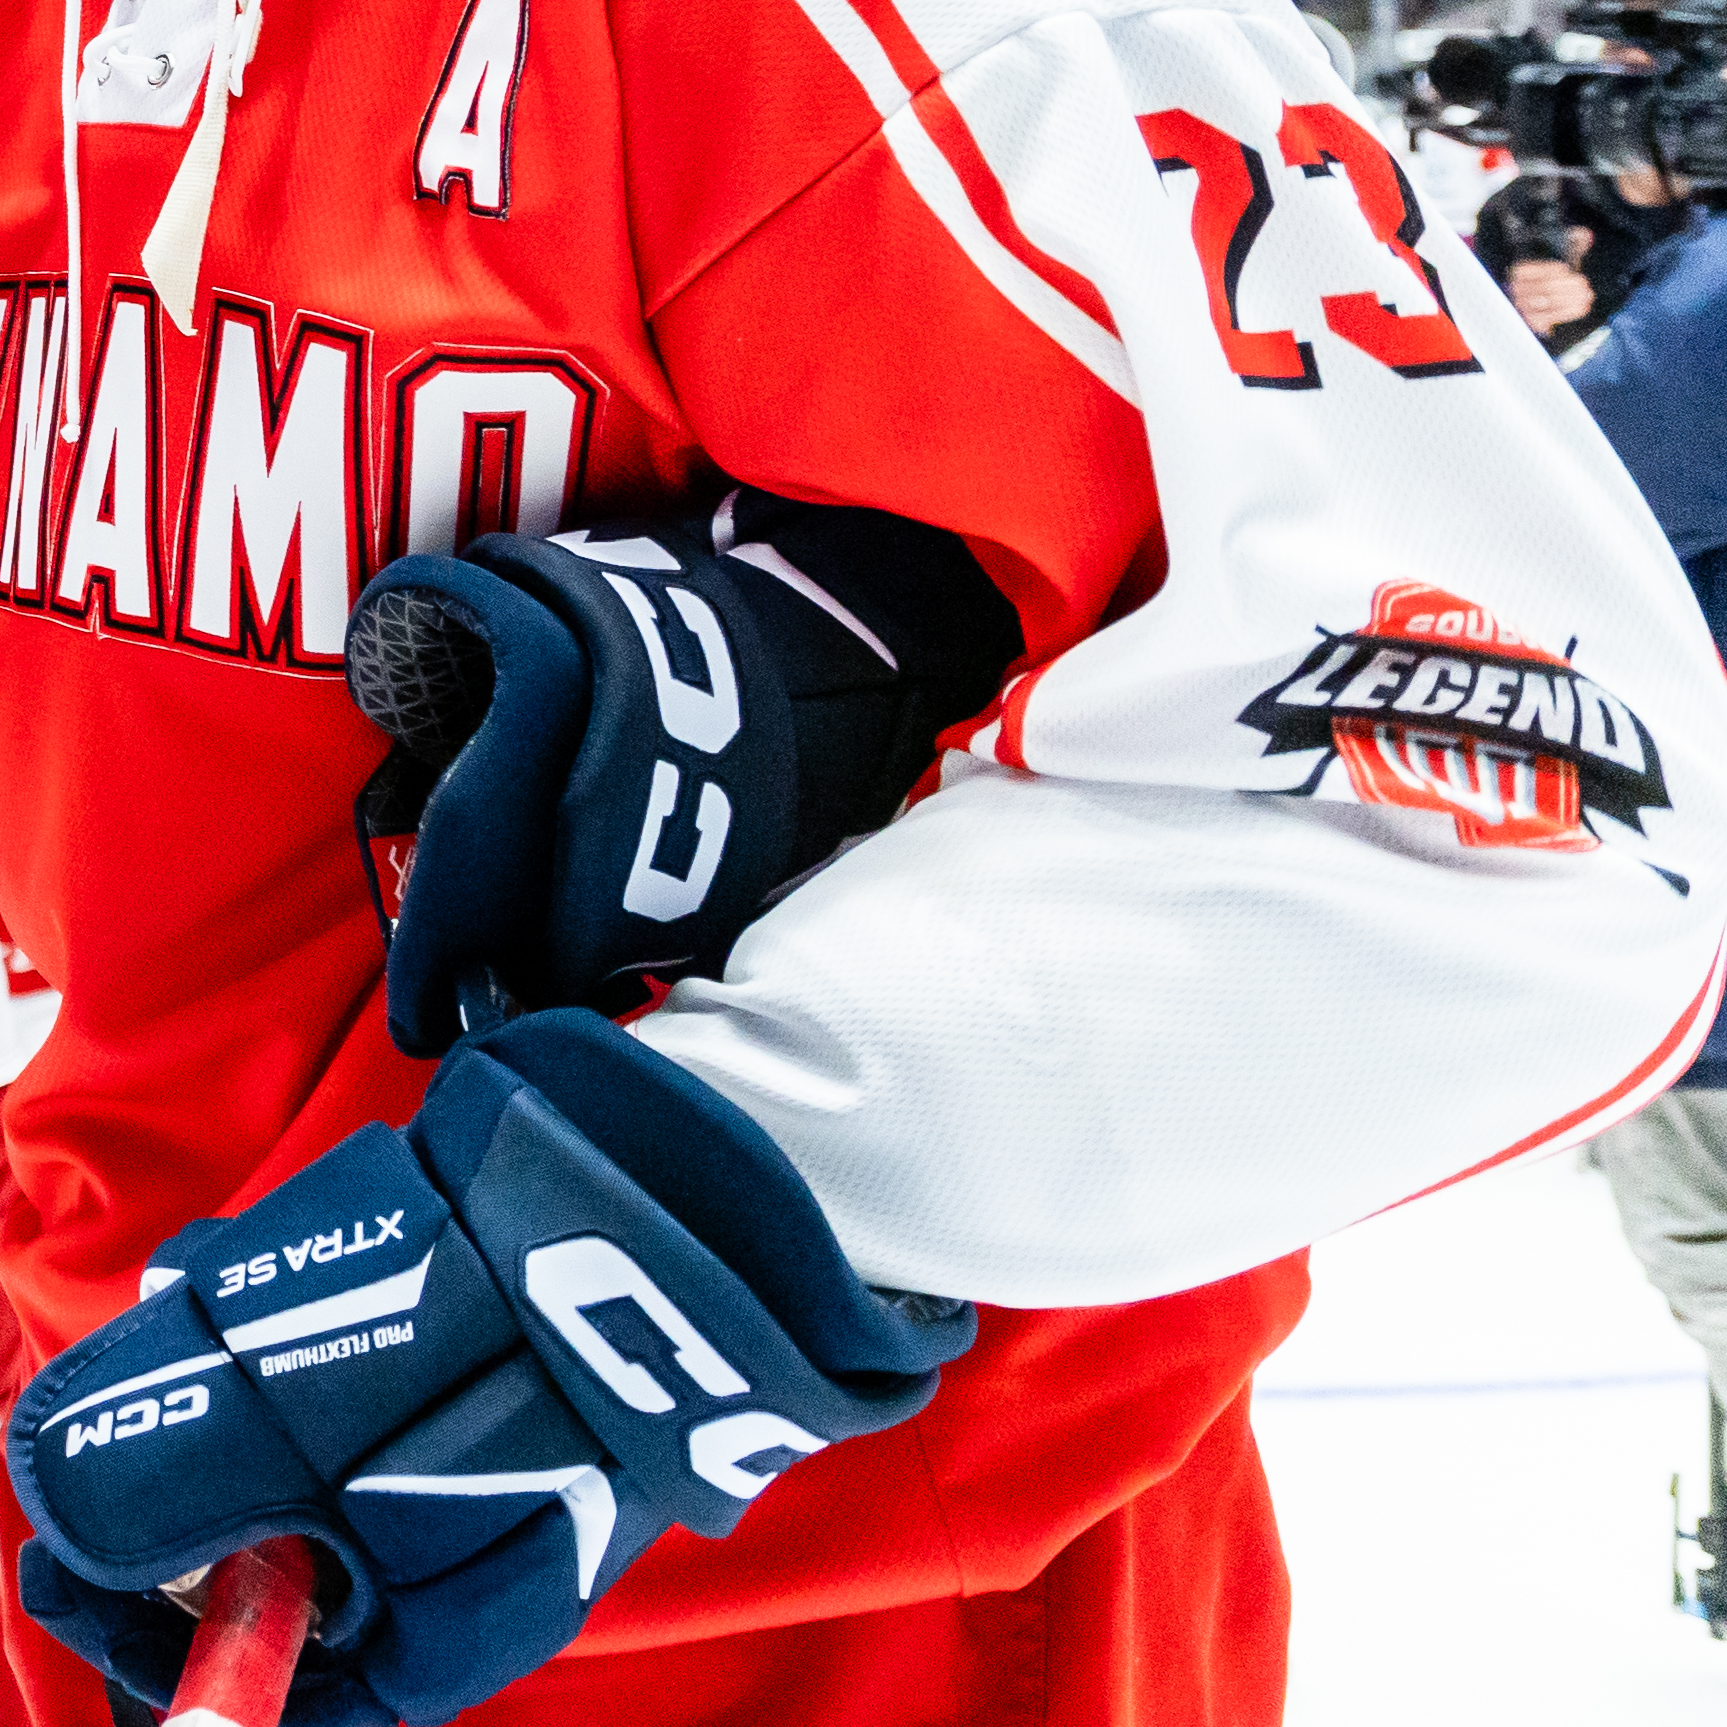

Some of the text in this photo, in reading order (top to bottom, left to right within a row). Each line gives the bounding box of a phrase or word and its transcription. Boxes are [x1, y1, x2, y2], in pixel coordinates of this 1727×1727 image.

[1134, 98, 1486, 390] 23
[1276, 634, 1647, 774] LEGEND
[217, 1209, 404, 1298] XTRA SE
[259, 1320, 414, 1377] PRO FLEXTHUMB
[65, 1383, 210, 1458] CCM
